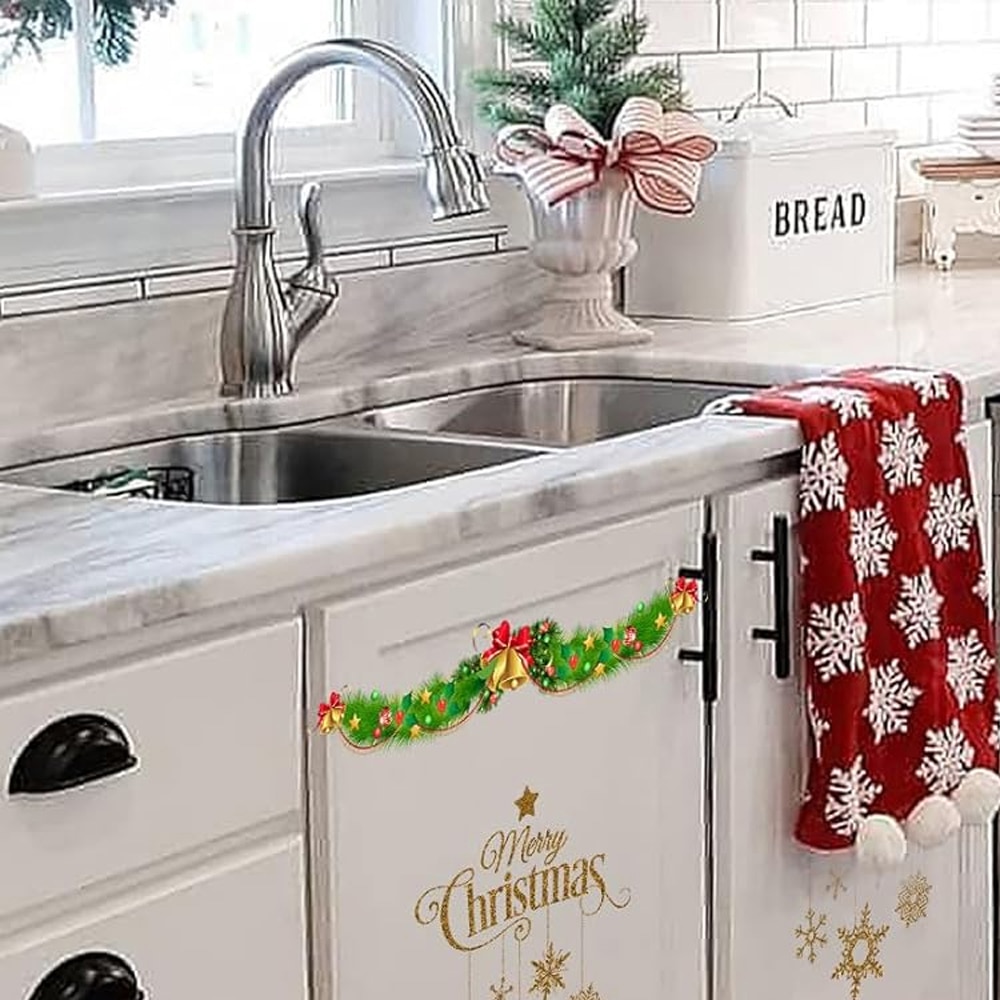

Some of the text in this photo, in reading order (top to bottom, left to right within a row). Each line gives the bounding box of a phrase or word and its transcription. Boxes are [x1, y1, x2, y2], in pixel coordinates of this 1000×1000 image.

[775, 193, 866, 237] BREAD
[480, 826, 568, 874] Merry
[414, 853, 631, 952] Christmas
